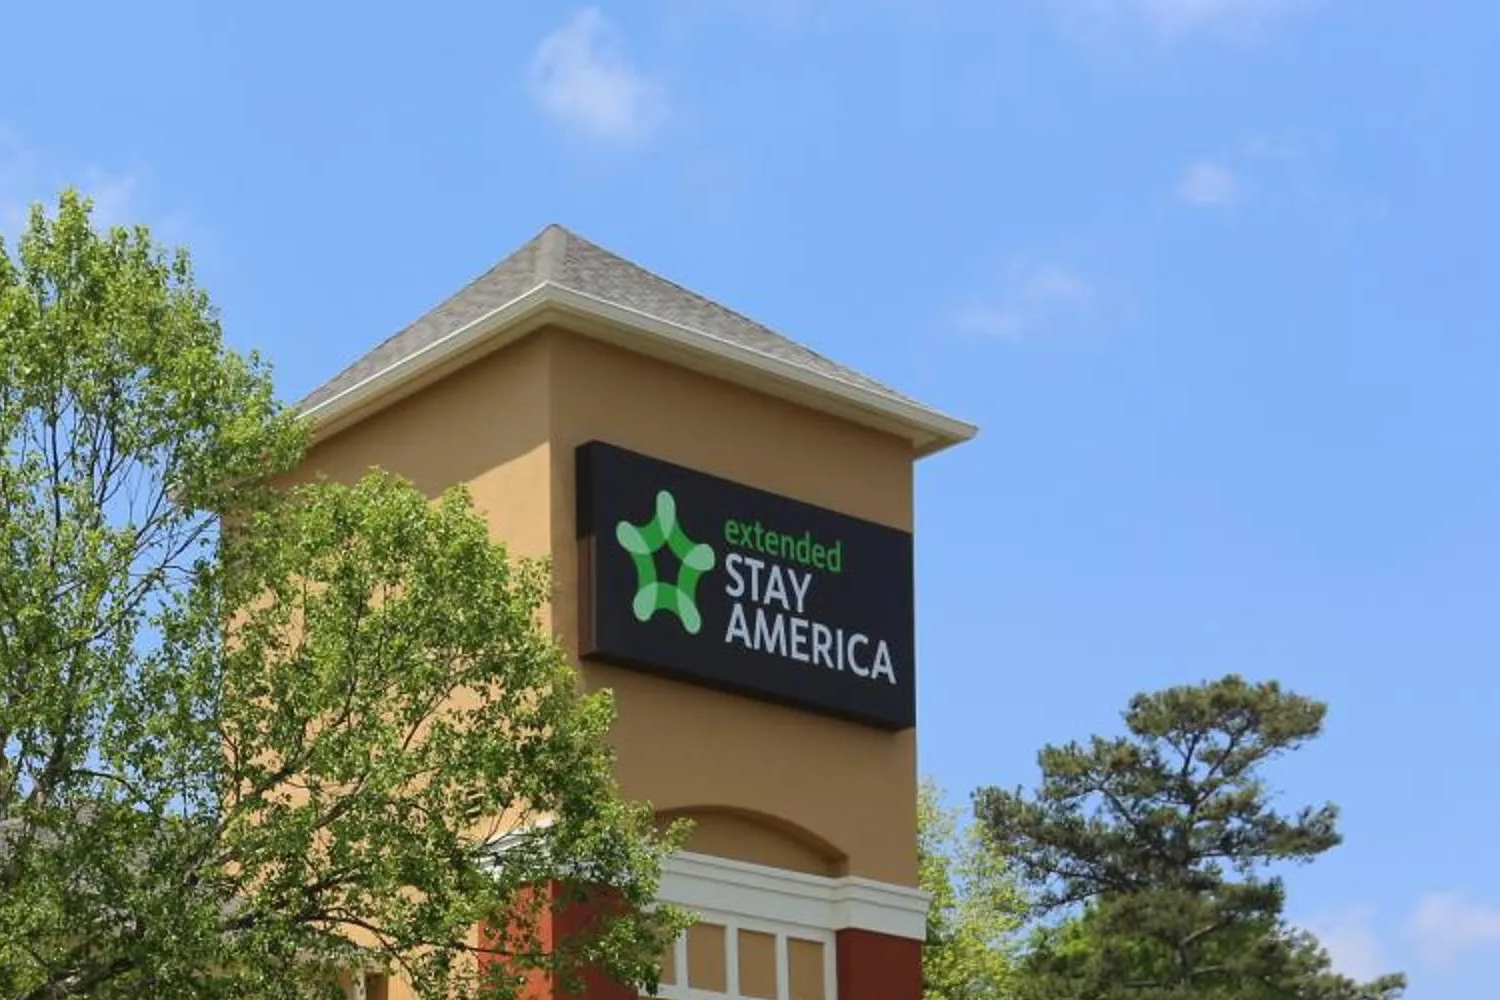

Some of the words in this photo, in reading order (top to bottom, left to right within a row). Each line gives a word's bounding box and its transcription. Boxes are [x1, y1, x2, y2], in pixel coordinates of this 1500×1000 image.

[724, 519, 841, 572] extended
[724, 553, 813, 613] STAY
[724, 603, 897, 684] AMERICA
